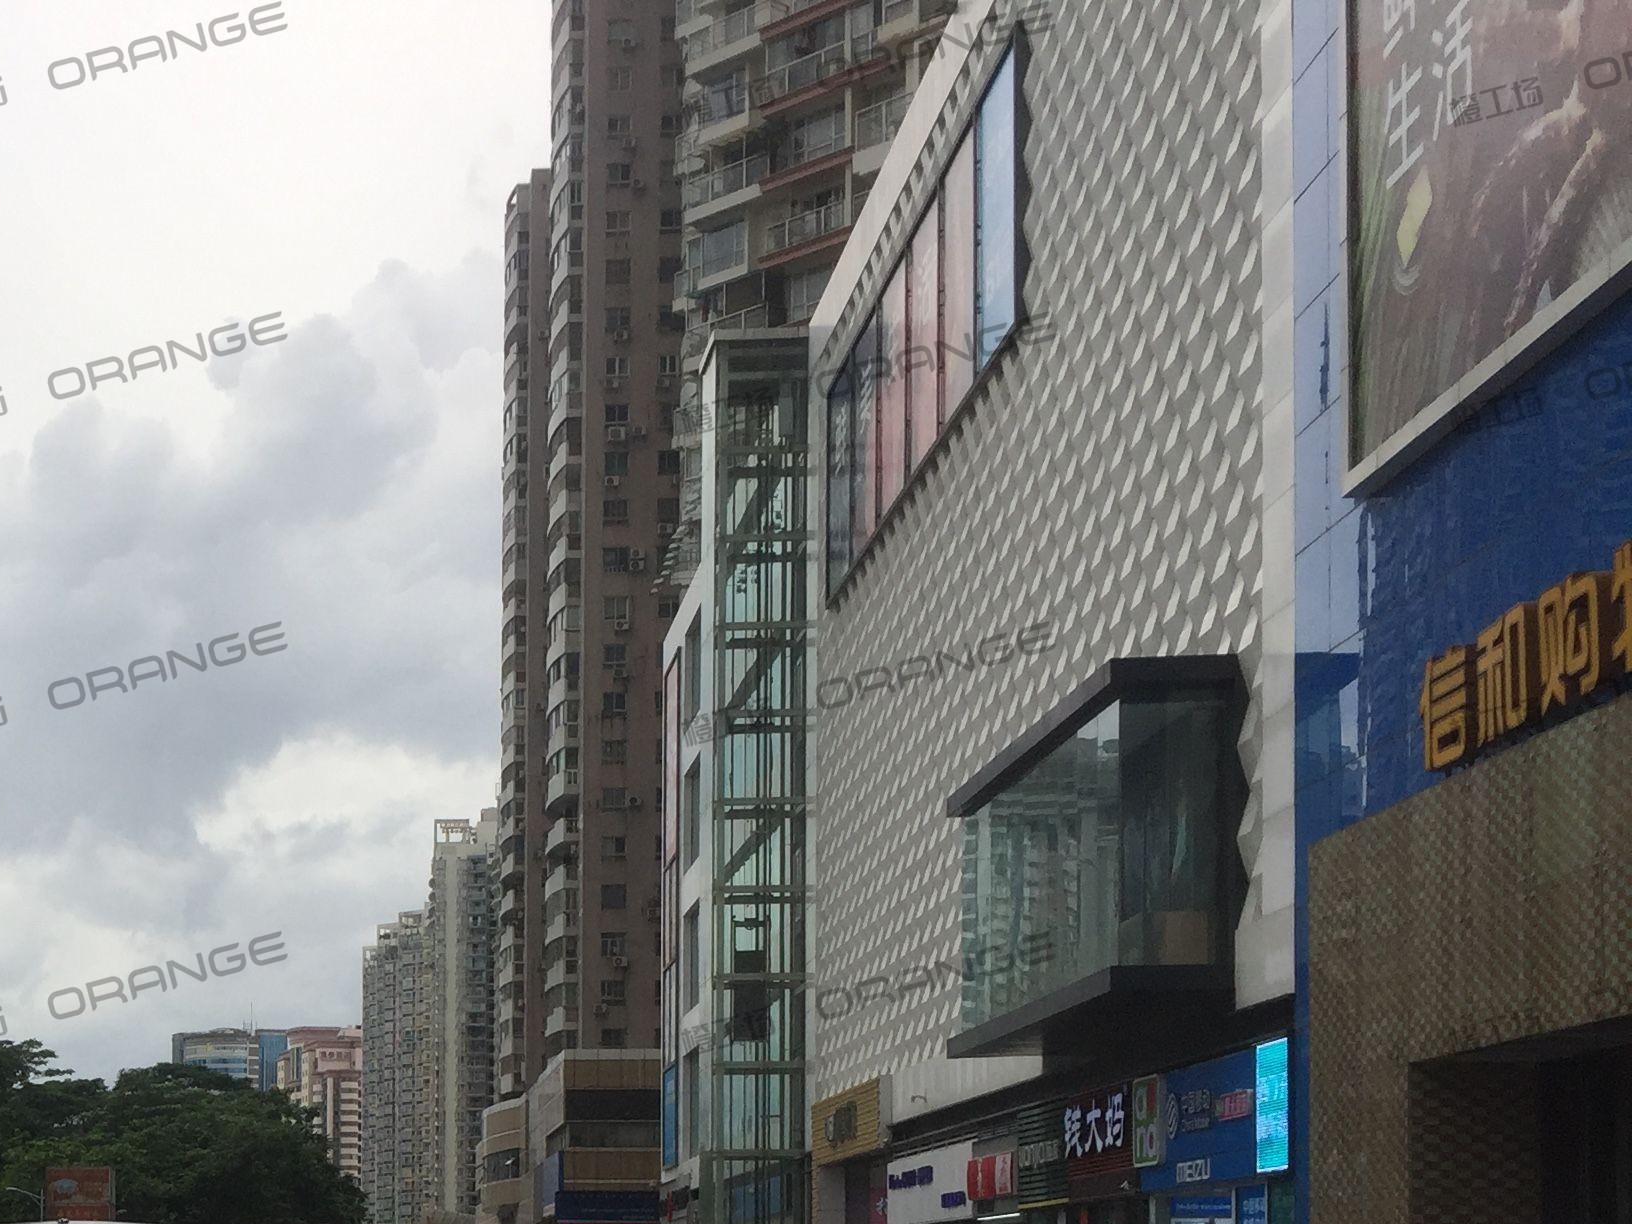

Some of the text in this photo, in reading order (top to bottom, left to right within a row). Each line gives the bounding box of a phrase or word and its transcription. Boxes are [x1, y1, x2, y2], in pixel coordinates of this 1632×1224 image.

[1064, 1092, 1125, 1159] 钱大妈
[1176, 1159, 1210, 1183] MEIZU
